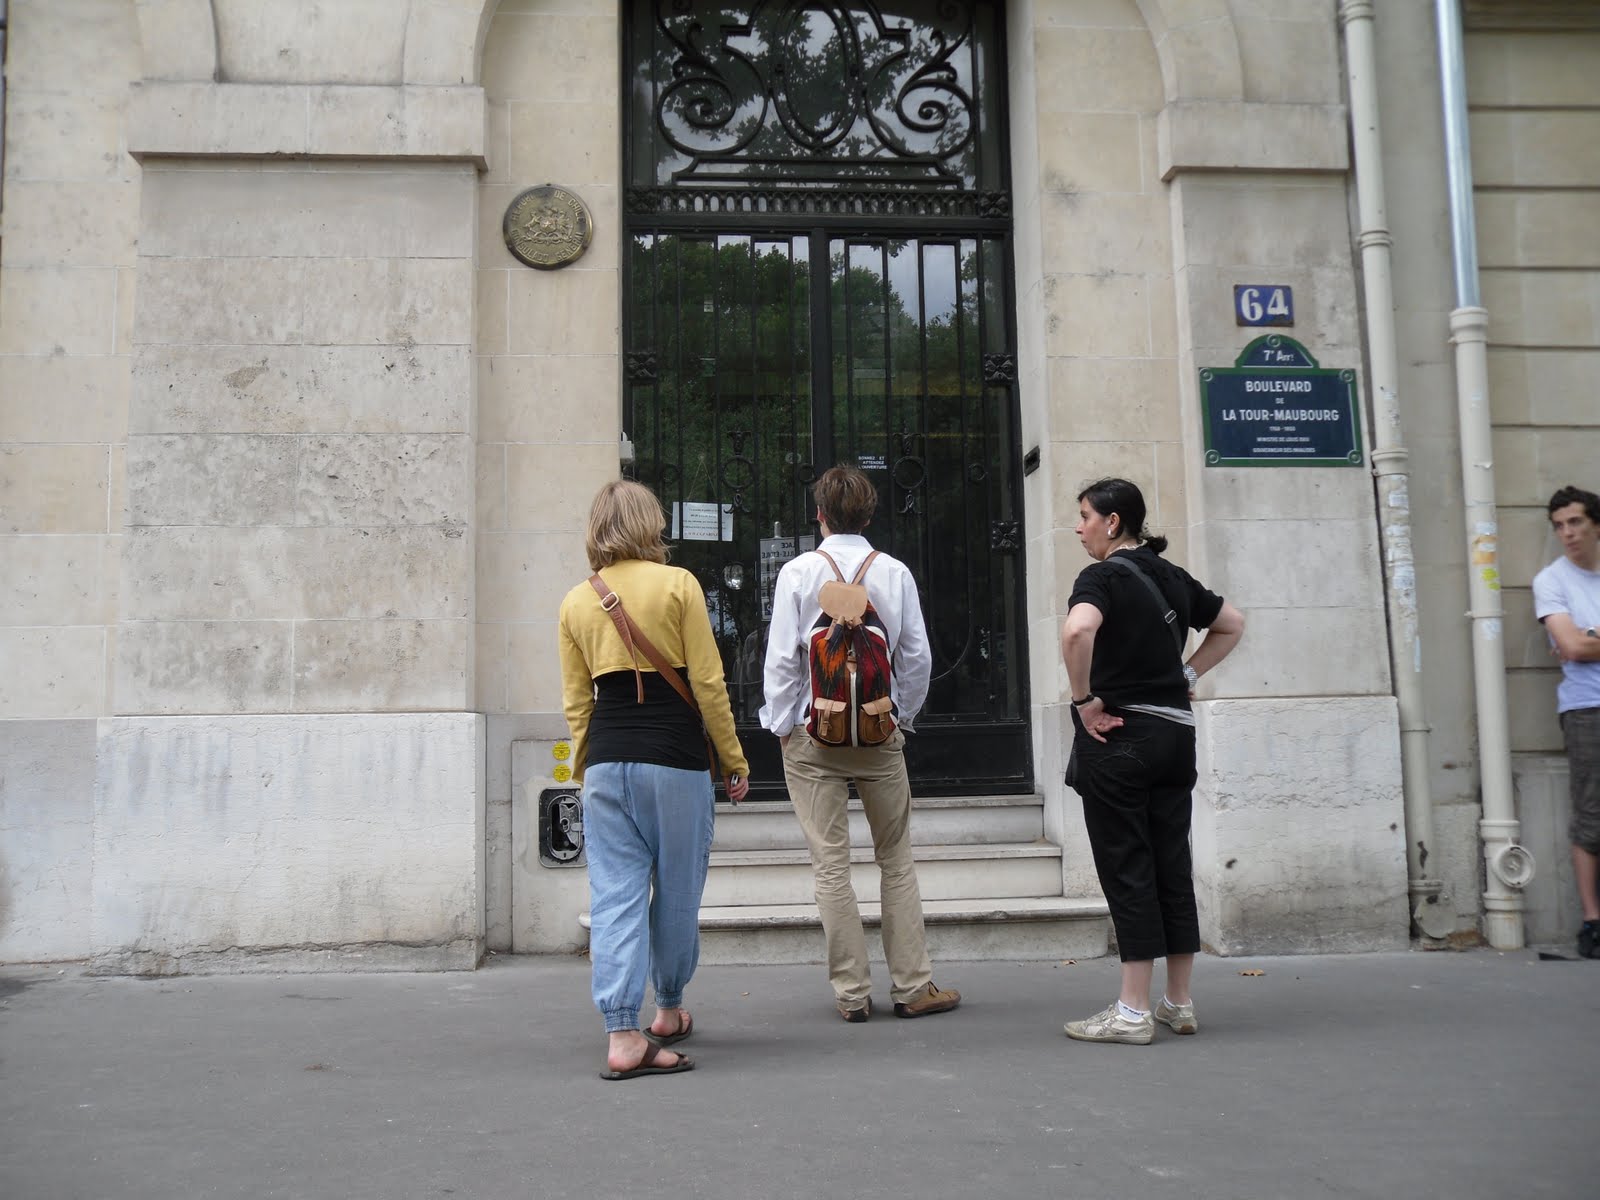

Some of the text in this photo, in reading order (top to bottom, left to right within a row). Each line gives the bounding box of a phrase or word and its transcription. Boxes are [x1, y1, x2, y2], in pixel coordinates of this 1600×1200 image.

[554, 189, 567, 201] DE
[555, 231, 585, 261] GENERAL
[1241, 288, 1289, 321] 64
[1245, 380, 1312, 392] BOULEVARD
[1222, 409, 1340, 421] LA TOUR-MAUBOURG
